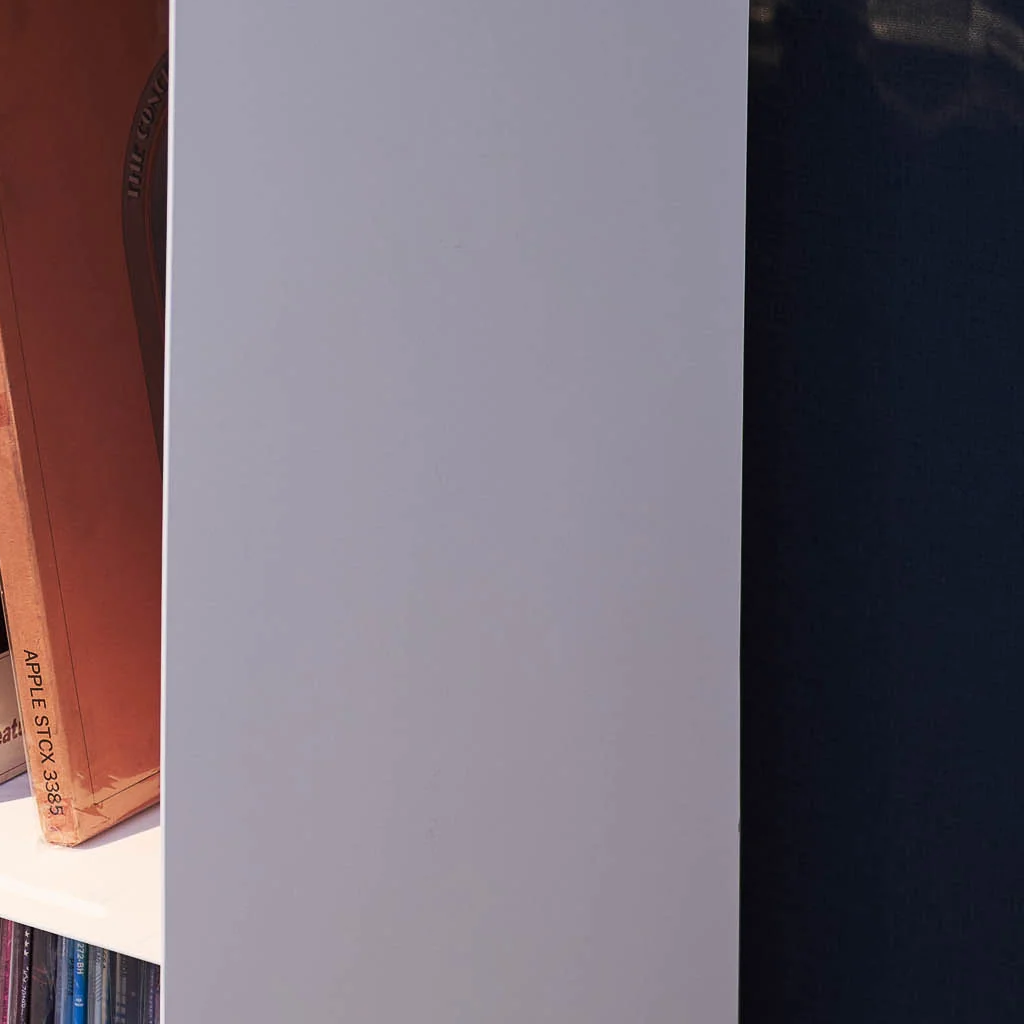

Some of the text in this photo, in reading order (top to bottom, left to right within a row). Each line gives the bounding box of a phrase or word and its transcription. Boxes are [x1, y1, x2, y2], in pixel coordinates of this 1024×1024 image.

[23, 649, 64, 817] APPLE STCX 3385
